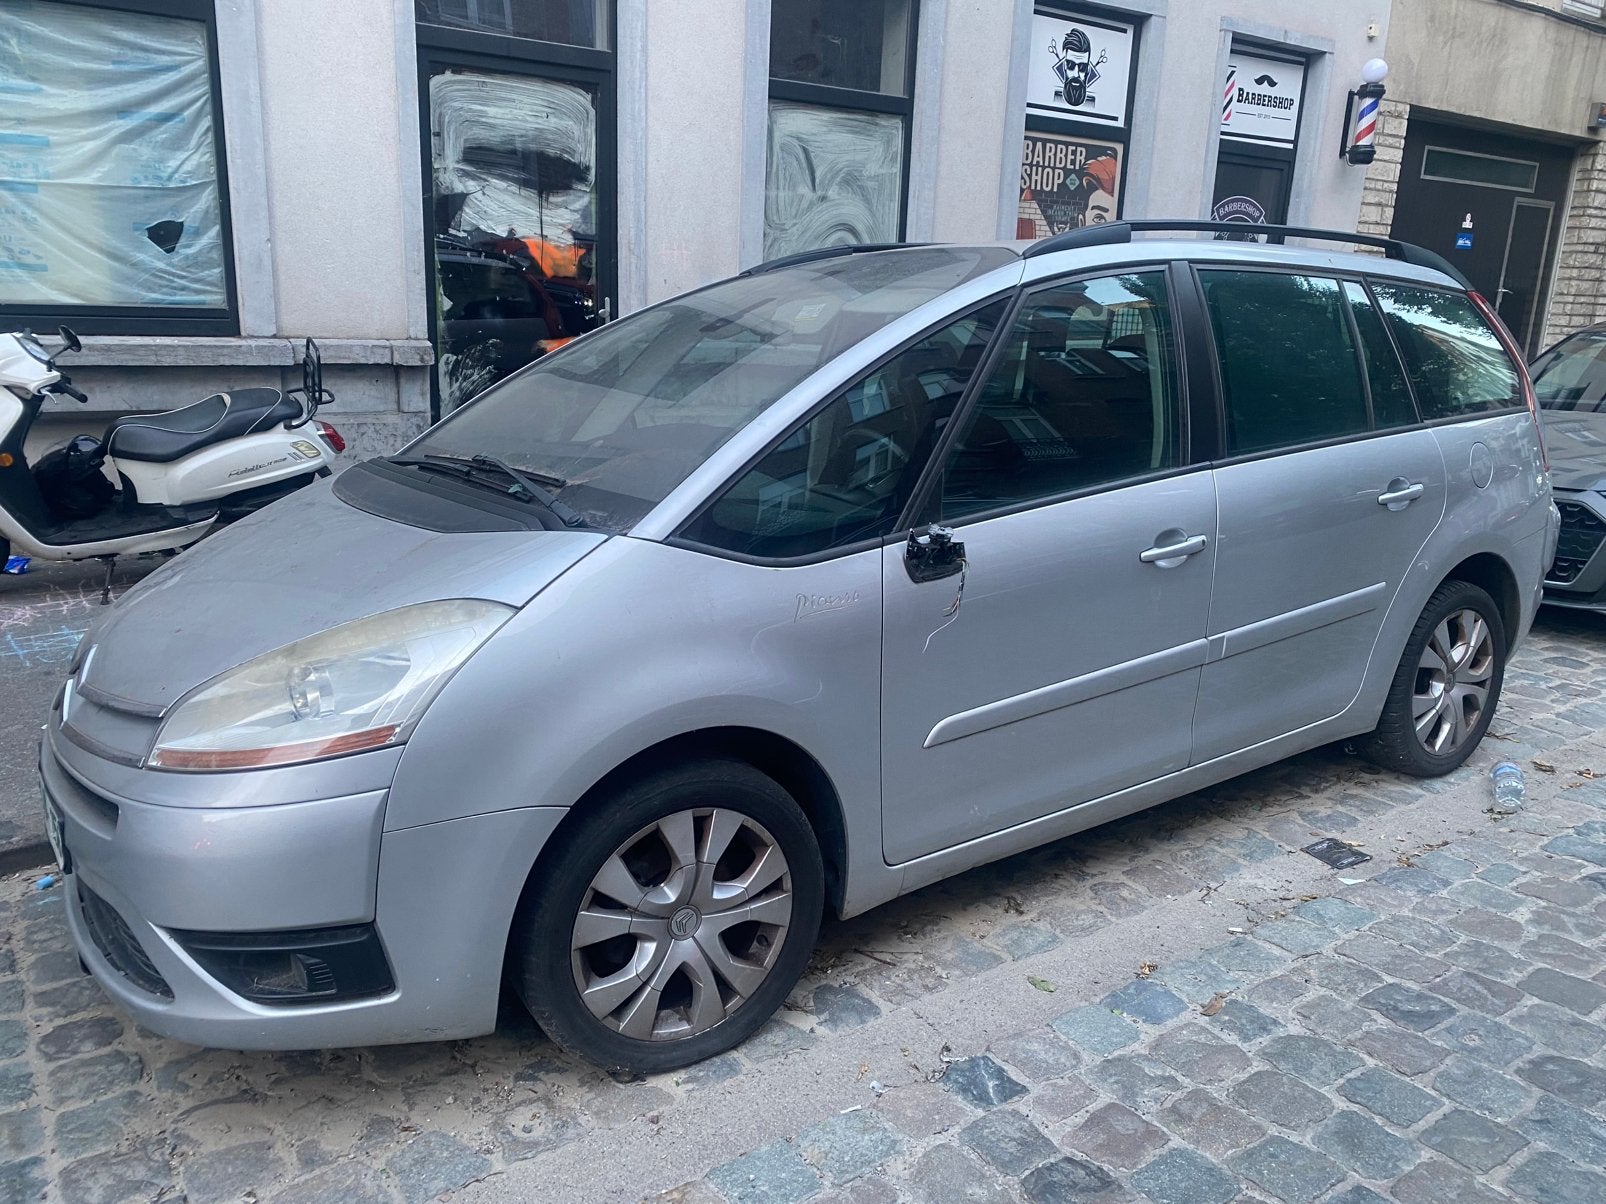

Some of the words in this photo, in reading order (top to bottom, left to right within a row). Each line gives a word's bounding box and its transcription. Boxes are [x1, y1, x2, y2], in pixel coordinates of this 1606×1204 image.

[1022, 140, 1087, 170] BARBER
[1021, 165, 1065, 192] SHOP
[1219, 202, 1261, 218] BARBERSHOP
